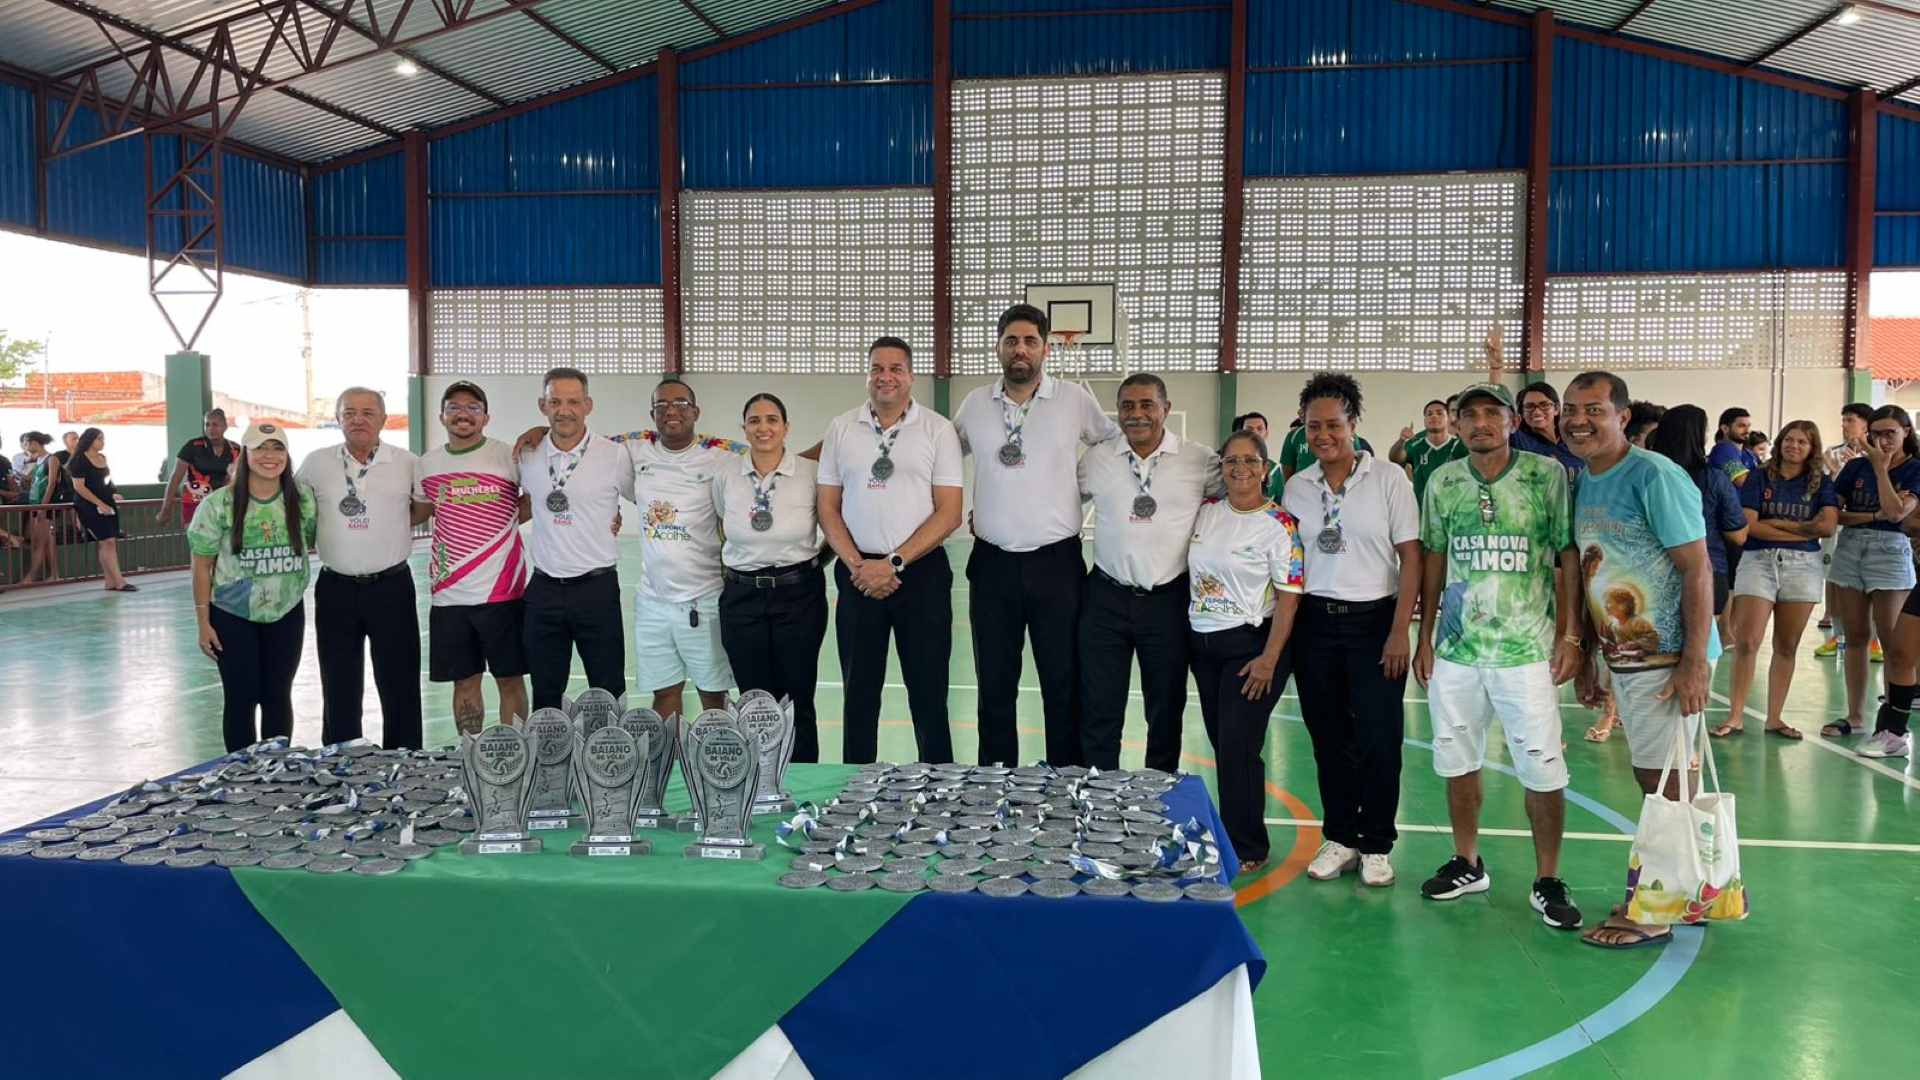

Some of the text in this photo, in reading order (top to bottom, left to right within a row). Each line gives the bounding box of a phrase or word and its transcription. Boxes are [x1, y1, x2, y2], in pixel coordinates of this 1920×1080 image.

[1454, 535, 1528, 550] CASA NOVA
[255, 556, 303, 575] AMOR
[1471, 550, 1528, 572] AMOR
[480, 742, 520, 752] BAIANO
[591, 744, 631, 754] BAIANO
[705, 746, 743, 756] BAIANO
